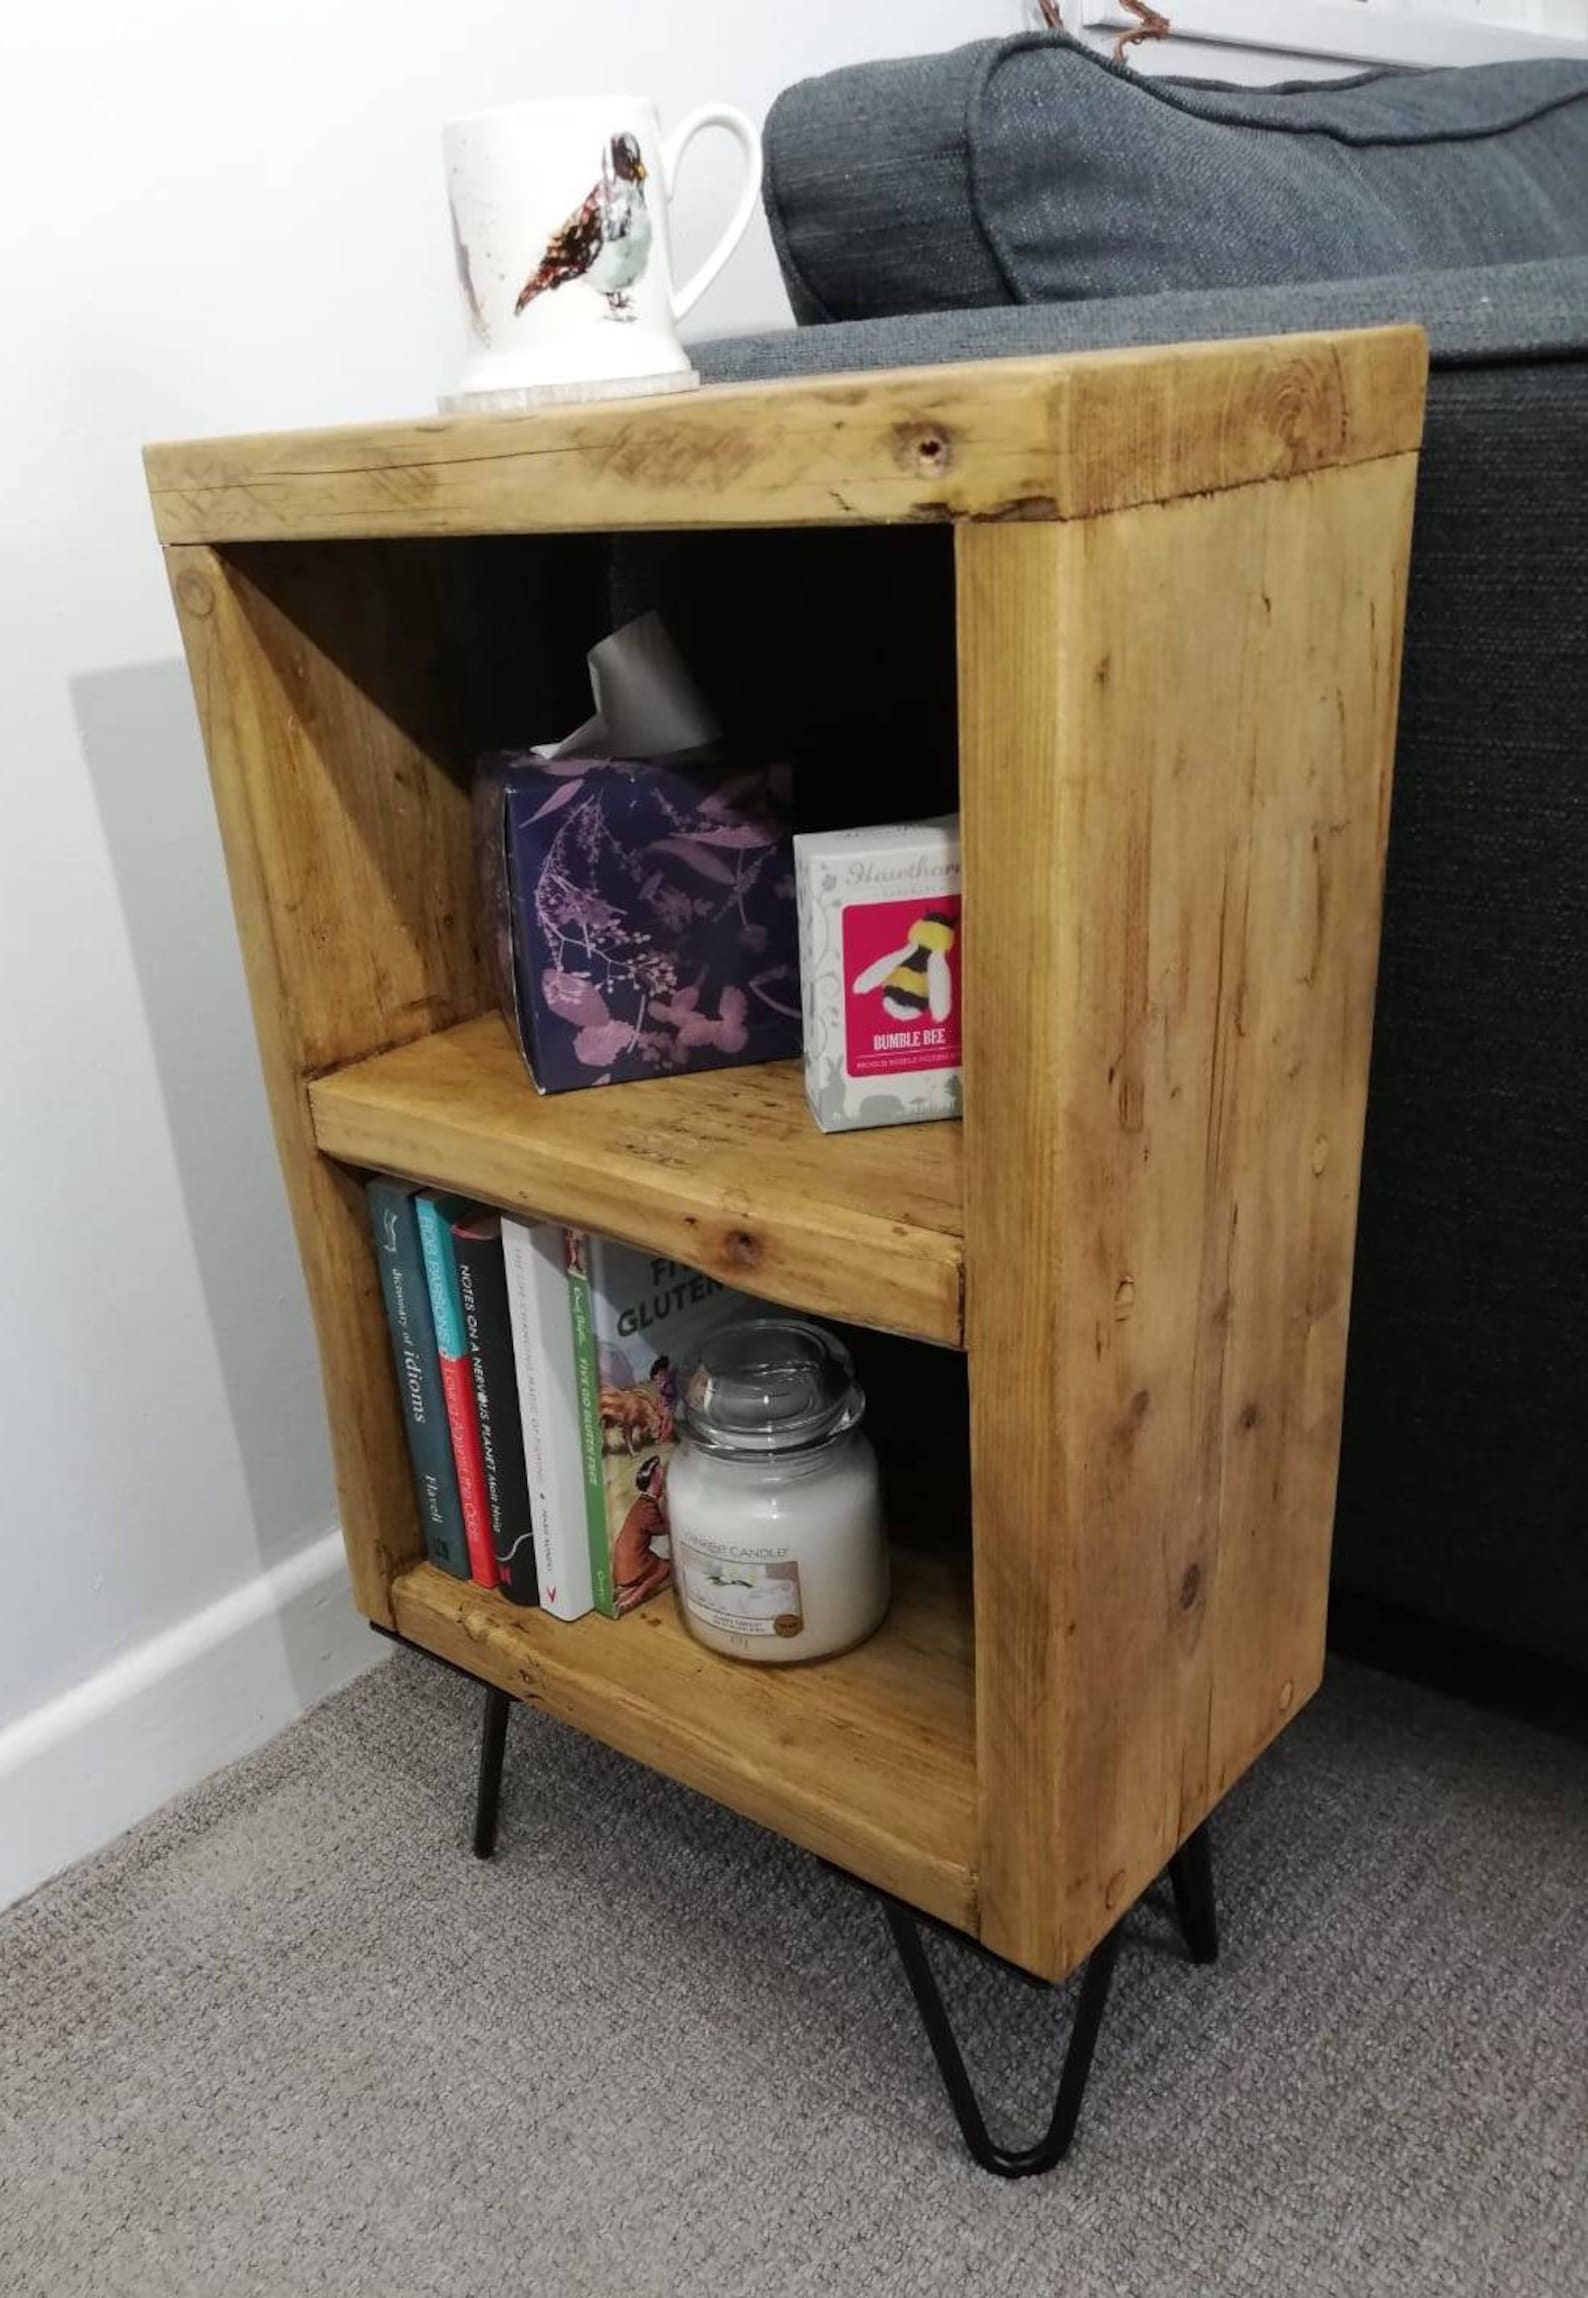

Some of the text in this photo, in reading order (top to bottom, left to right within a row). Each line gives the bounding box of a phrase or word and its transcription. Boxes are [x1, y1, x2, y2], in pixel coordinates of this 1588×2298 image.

[873, 1028, 946, 1051] BUMBLE BEE
[428, 1258, 450, 1345] PARSONS
[460, 1264, 476, 1312] NOTES
[467, 1315, 479, 1339] ON
[470, 1341, 480, 1352] A
[404, 1351, 426, 1424] idioms
[481, 1423, 496, 1471] PLANET
